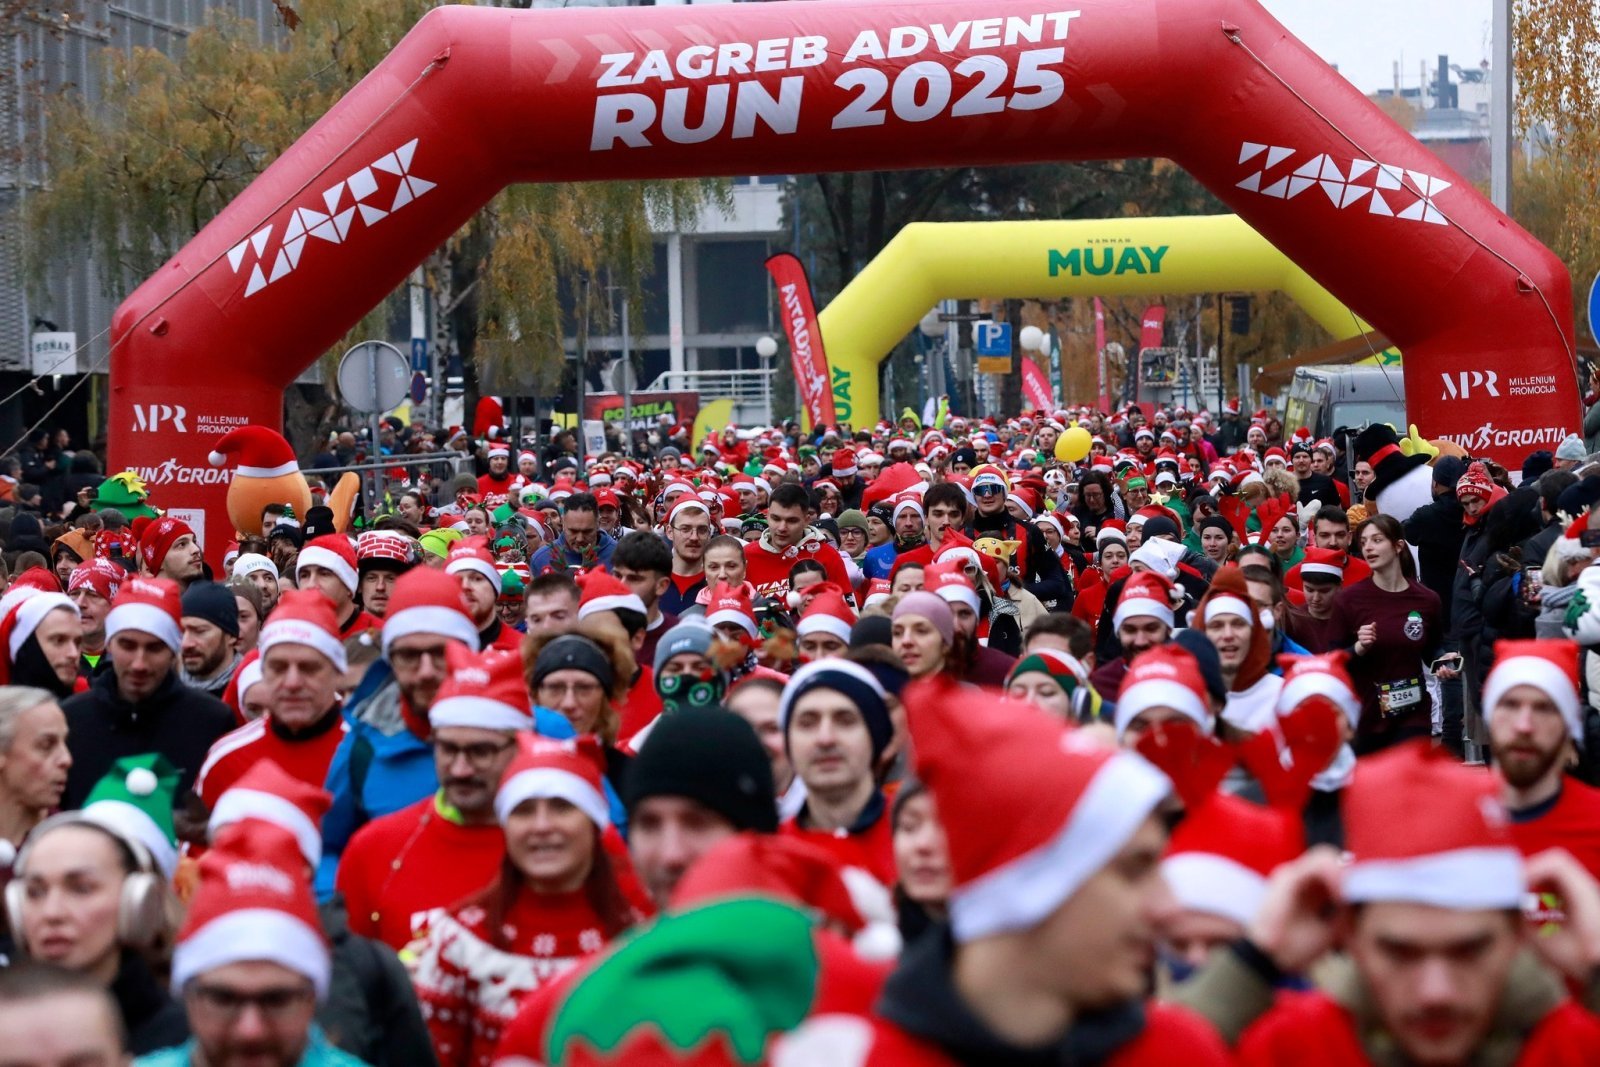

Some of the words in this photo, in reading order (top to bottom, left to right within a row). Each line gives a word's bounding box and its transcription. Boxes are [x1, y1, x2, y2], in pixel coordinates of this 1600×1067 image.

[597, 35, 828, 88] ZAGREB
[842, 9, 1081, 63] ADVENT
[590, 75, 804, 151] RUN
[831, 47, 1065, 130] 2025
[1048, 245, 1169, 277] MUAY
[986, 324, 1003, 348] P
[833, 366, 851, 422] UAY
[1441, 370, 1500, 400] MPR
[1509, 376, 1556, 386] MILLENIUM
[1510, 386, 1557, 396] PROMOCIJA
[132, 404, 187, 433] MPR
[198, 415, 249, 425] MILLENIUM
[197, 425, 238, 434] PROMOC
[1494, 427, 1567, 447] CROATIA
[177, 467, 239, 485] CROAT
[1392, 690, 1413, 702] 3264
